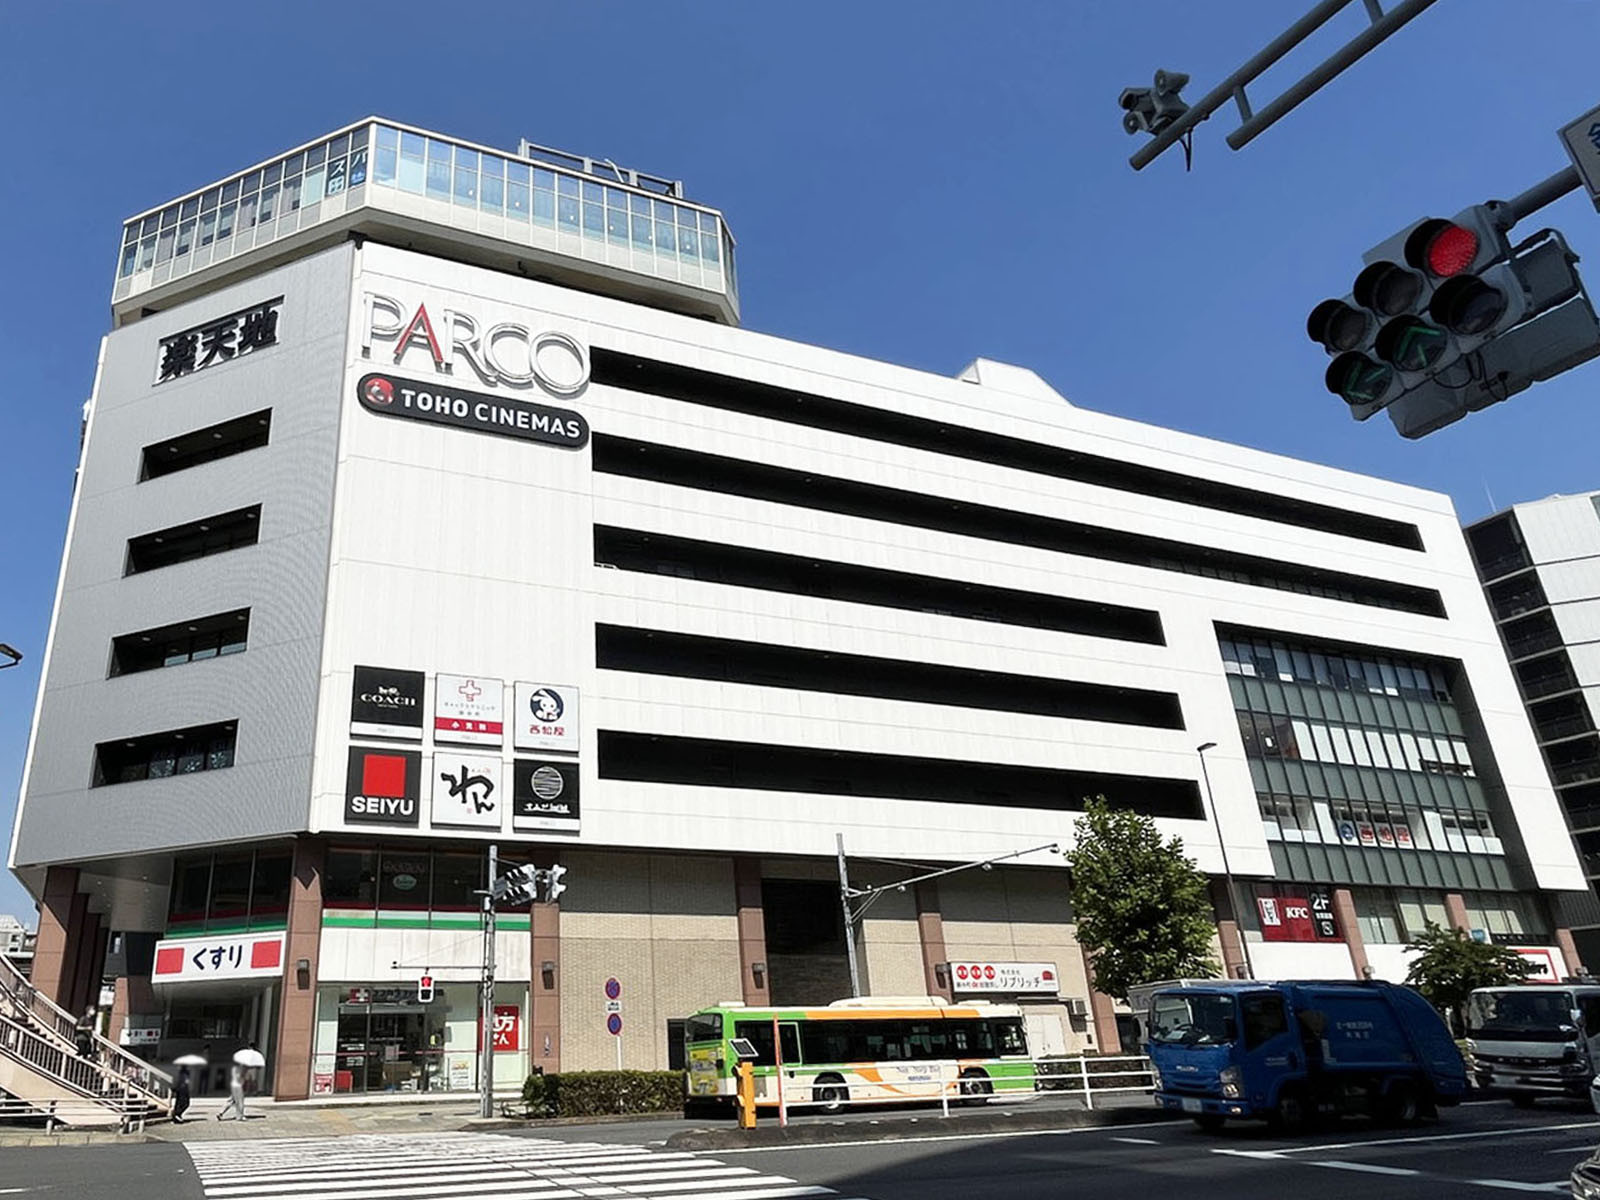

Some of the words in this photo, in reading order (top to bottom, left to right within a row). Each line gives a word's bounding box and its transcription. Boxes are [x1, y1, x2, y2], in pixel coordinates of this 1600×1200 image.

[160, 305, 278, 379] 楽天地
[362, 291, 590, 396] PARCO
[401, 389, 469, 418] TOHO
[475, 403, 581, 439] CINEMAS
[360, 693, 416, 706] COACH
[441, 764, 495, 815] わん
[351, 796, 414, 815] SEIYU
[1285, 906, 1309, 919] KFC
[1311, 893, 1329, 910] 2F
[192, 943, 243, 971] くすり
